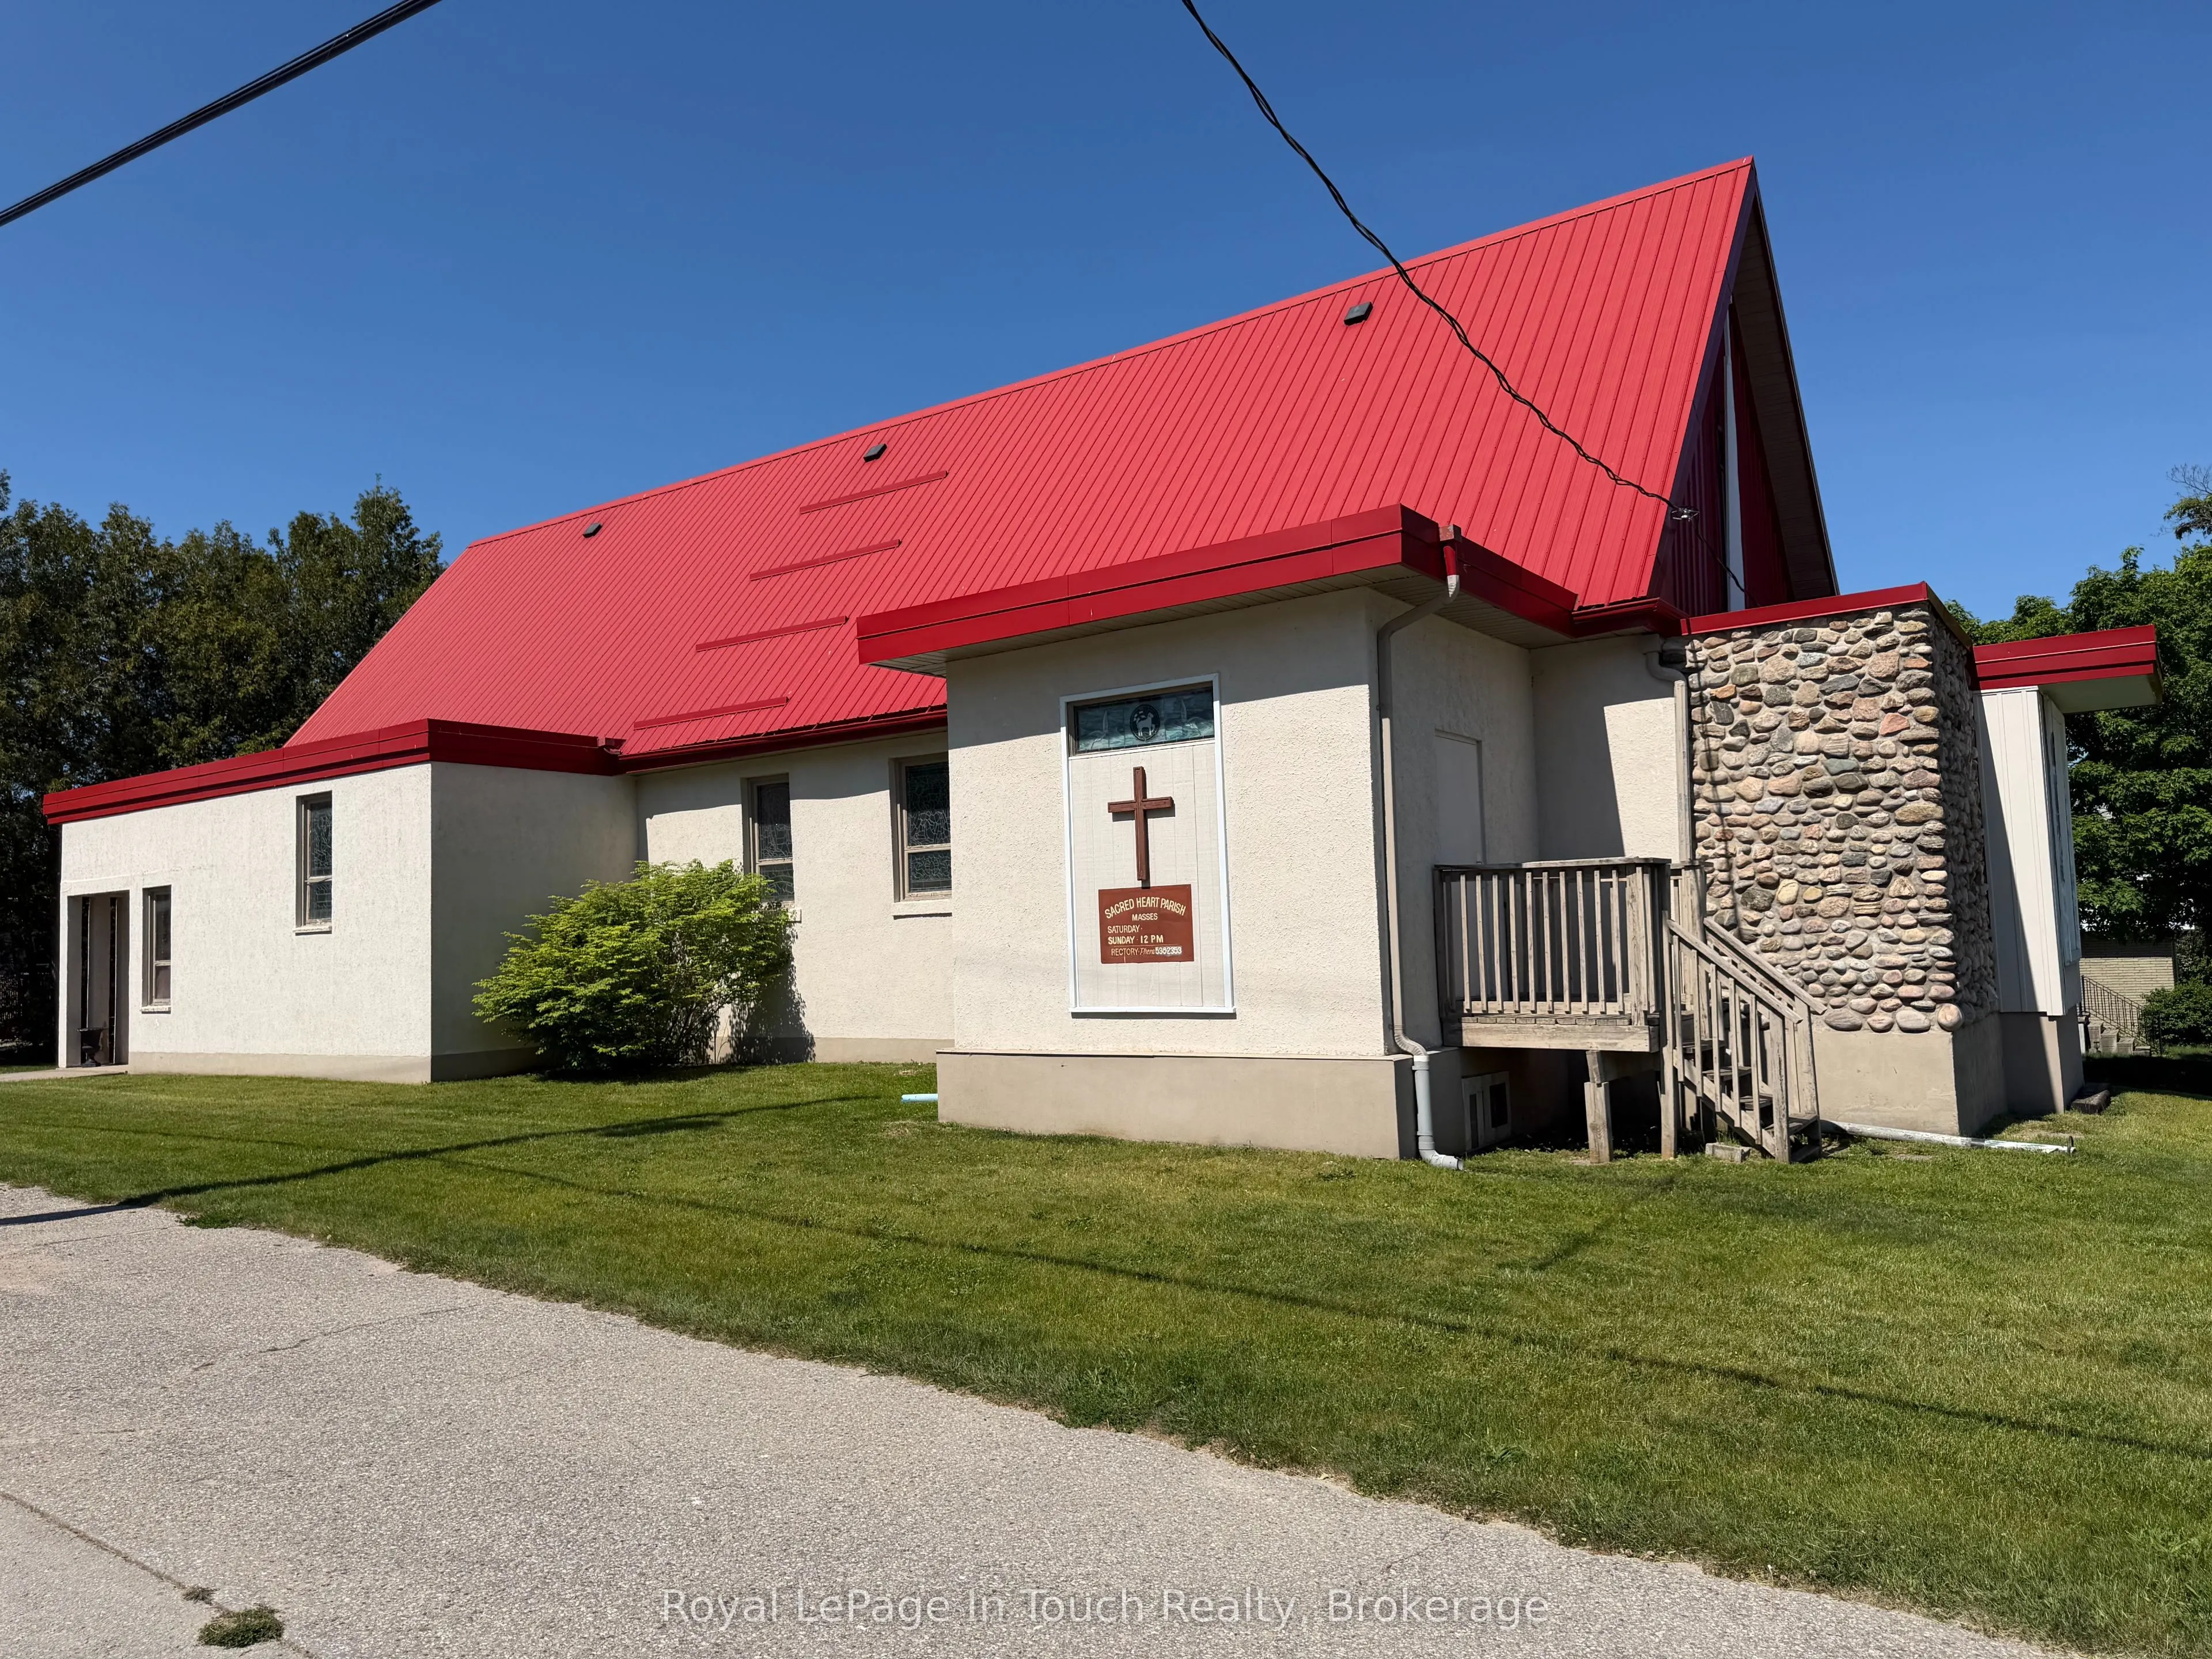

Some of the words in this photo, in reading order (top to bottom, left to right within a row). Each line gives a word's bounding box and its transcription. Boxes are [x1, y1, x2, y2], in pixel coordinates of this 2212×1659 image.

[1104, 899, 1134, 919] SACRED
[1136, 896, 1160, 908] HEART
[1160, 897, 1186, 916] PARISH
[1132, 912, 1158, 921] MASSES
[1107, 925, 1140, 934] SATURDAY
[1108, 935, 1135, 945] SUNDAY
[1140, 935, 1149, 944] 12
[1151, 934, 1164, 943] PM
[1111, 948, 1139, 956] RECTORY
